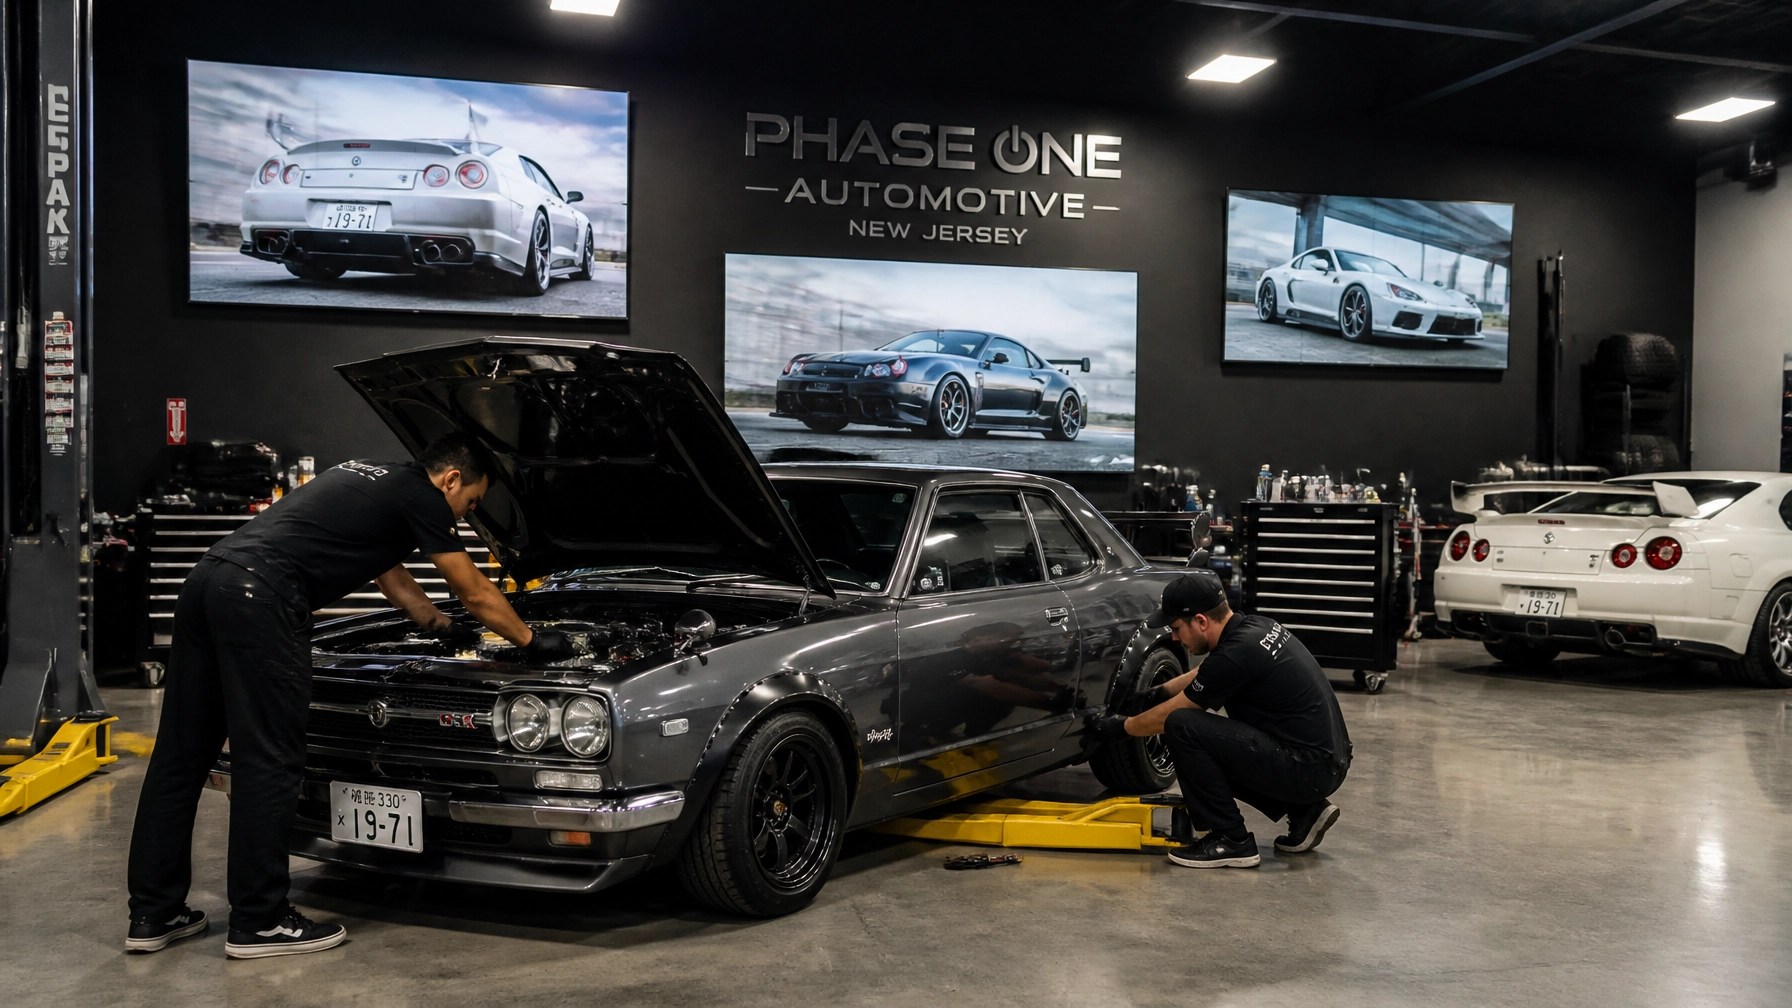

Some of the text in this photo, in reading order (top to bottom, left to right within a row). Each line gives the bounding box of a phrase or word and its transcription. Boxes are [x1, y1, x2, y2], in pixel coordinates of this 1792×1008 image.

[745, 111, 1122, 179] PHASE ONE
[784, 177, 1085, 219] AUTOMOTIVE
[334, 212, 372, 229] 19-71
[849, 219, 1028, 245] NEW JERSEY
[1526, 599, 1560, 615] 19-71
[377, 791, 400, 809] 330
[353, 808, 414, 847] 19-71
